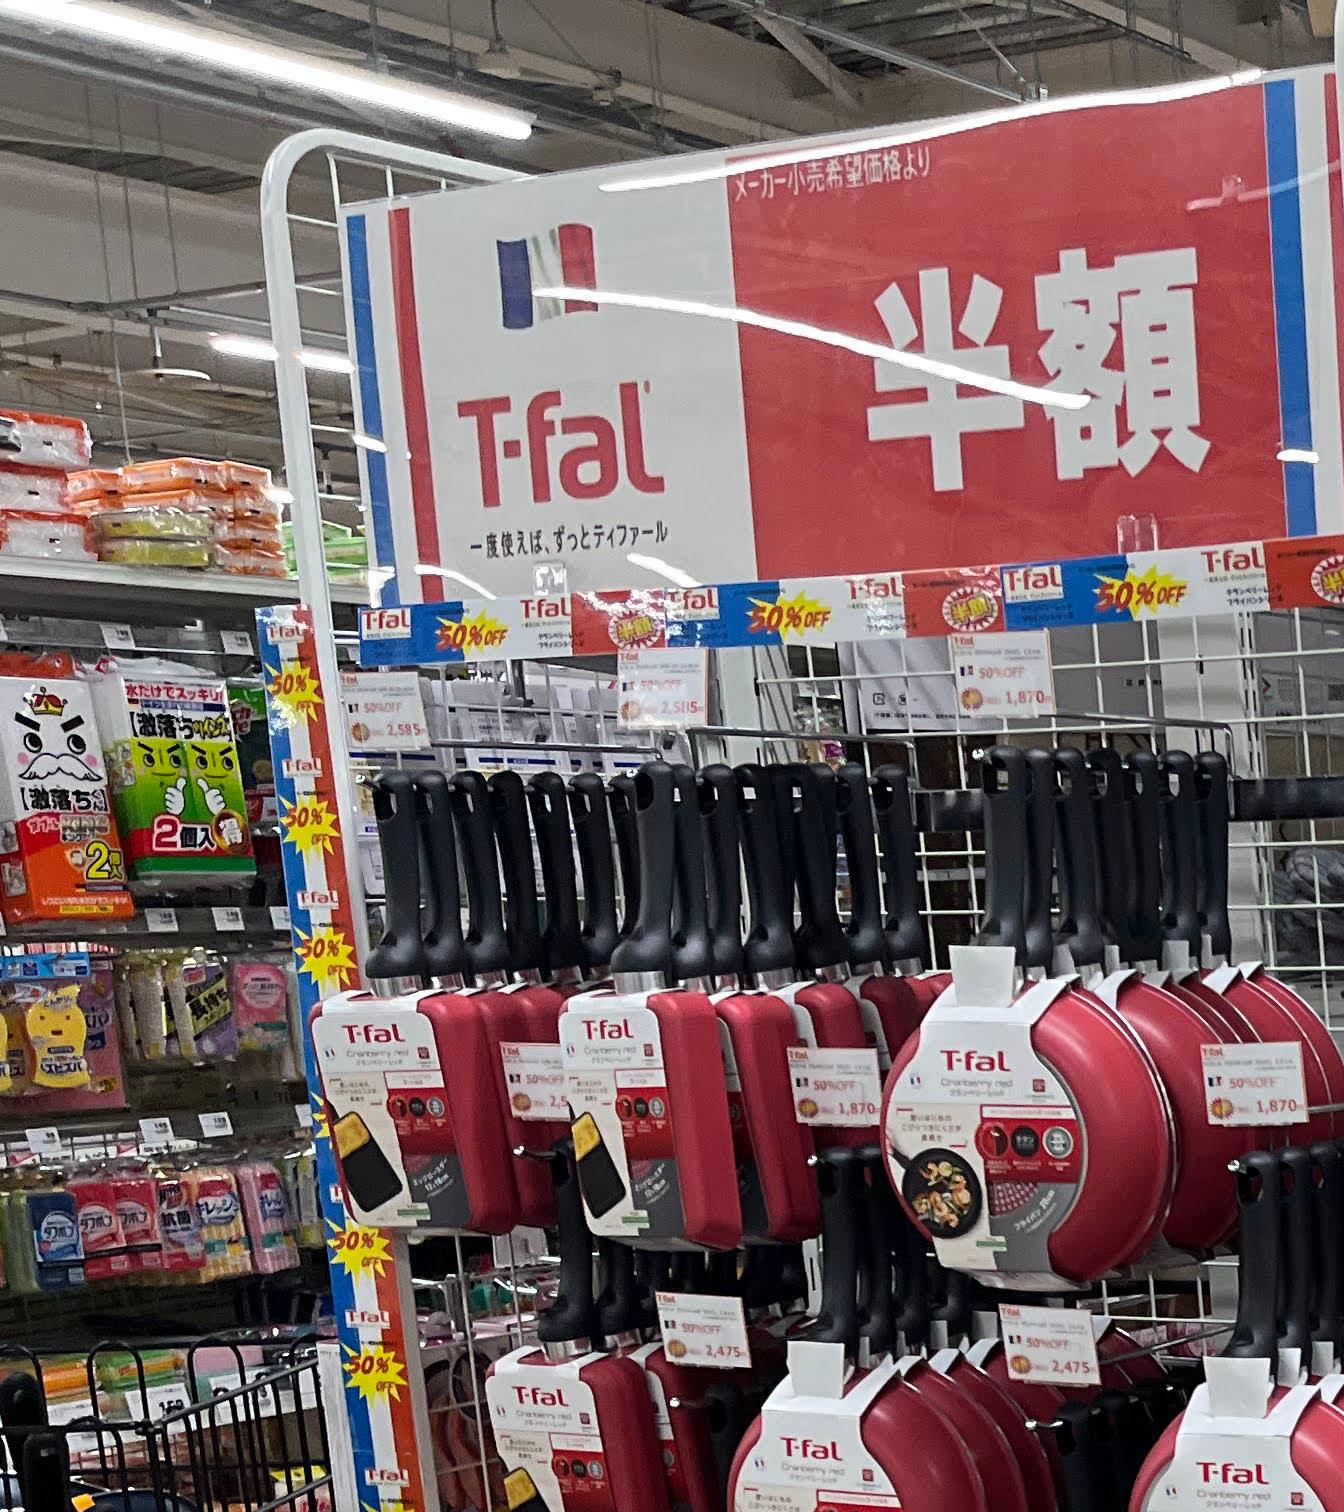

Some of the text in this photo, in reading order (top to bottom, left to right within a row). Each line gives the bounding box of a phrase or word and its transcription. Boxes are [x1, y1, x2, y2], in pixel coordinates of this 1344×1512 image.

[733, 148, 931, 200] メーカー小売希望価格より
[868, 248, 1211, 492] 半額
[458, 382, 664, 508] T-fal
[470, 522, 669, 558] 一度使えば、ずっとティファール
[1201, 549, 1264, 572] T-fal
[1005, 568, 1061, 589] T-fal
[846, 579, 900, 601] T-fal
[520, 598, 571, 619] T-fal
[362, 610, 411, 633] T-fal
[979, 668, 1024, 680] 50%OFF
[1005, 689, 1046, 705] 1,870
[155, 817, 215, 848] 2個入
[342, 1024, 405, 1044] T-fal
[582, 1019, 634, 1040] T-fal
[940, 1051, 1011, 1072] T-fal
[1229, 1077, 1276, 1089] 50%OFF
[838, 1101, 875, 1116] 1,870
[1256, 1099, 1296, 1113] 1,870
[1052, 1360, 1090, 1374] 2,475
[512, 1386, 568, 1407] T-fal
[780, 1437, 842, 1461] T-fal
[1196, 1462, 1269, 1484] T-fal
